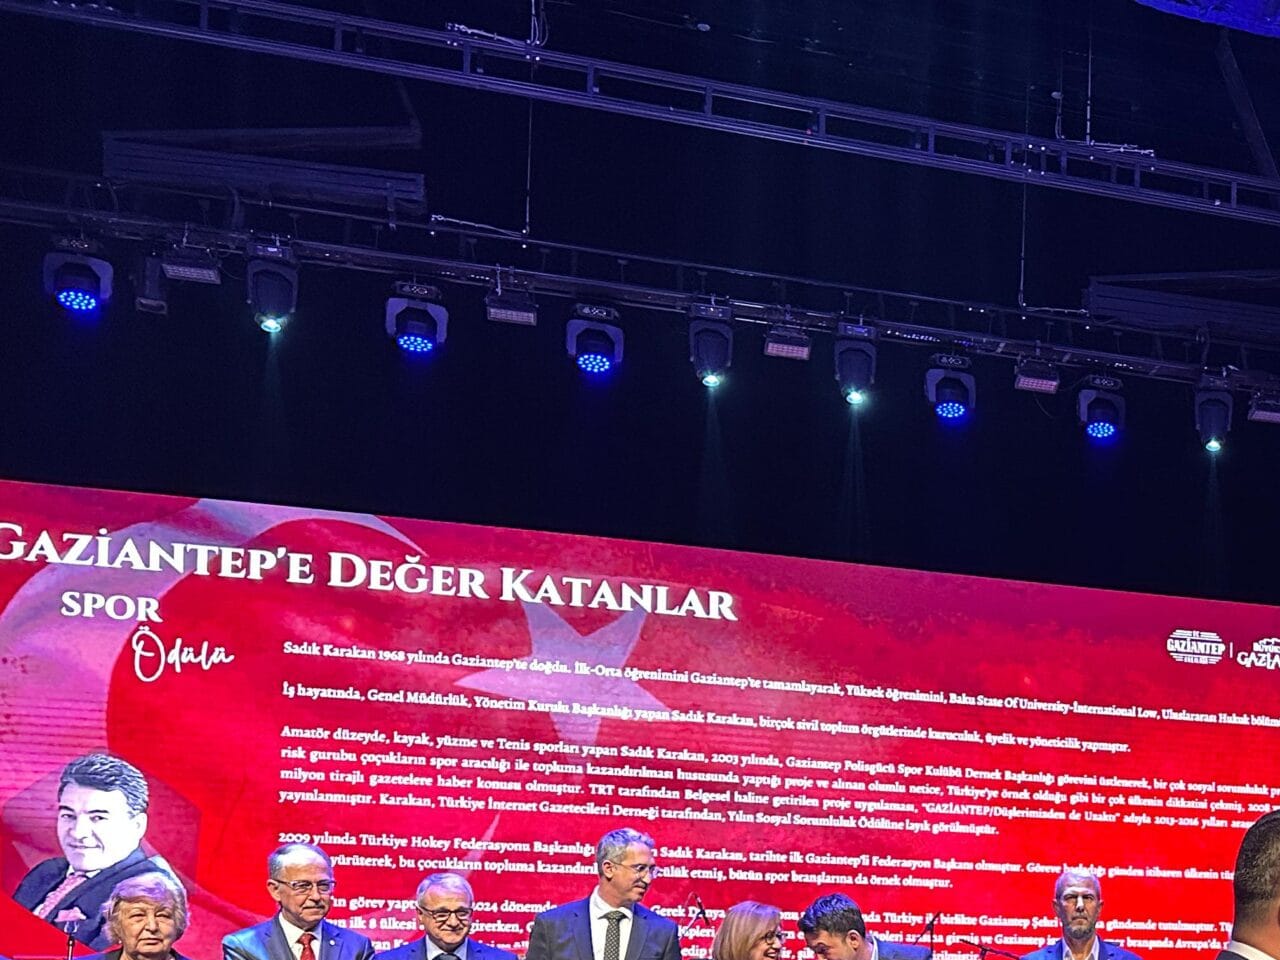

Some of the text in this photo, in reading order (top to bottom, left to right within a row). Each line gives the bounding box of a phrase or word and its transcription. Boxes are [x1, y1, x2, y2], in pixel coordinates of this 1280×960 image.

[0, 522, 738, 621] GAZİANTEP'E DEĞER KATANLAR
[61, 591, 163, 622] SPOR
[132, 626, 235, 682] Ödülü
[283, 641, 319, 656] Sadık
[323, 644, 375, 660] Karakan
[378, 650, 404, 662] 1968
[406, 650, 449, 665] yılında
[529, 658, 571, 676] doğdu.
[624, 667, 688, 683] öğrenimini
[763, 679, 844, 697] tamamlayarak,
[846, 684, 883, 698] Yüksek
[949, 693, 974, 705] Baku
[977, 695, 1002, 707] State
[1004, 697, 1018, 709] Of
[283, 681, 294, 698] İş
[297, 683, 364, 701] hayatında,
[367, 689, 403, 703] Genel
[406, 691, 471, 708] Müdürlük,
[474, 696, 525, 711] Yönetim
[528, 699, 569, 714] Kurulu
[572, 702, 632, 721] Başkanlığı
[634, 709, 669, 722] yapan
[672, 709, 704, 723] Sadık
[706, 712, 756, 728] Karakan,
[759, 715, 793, 731] birçok
[796, 718, 818, 731] sivil
[1017, 737, 1027, 746] ve
[281, 725, 329, 739] Amatör
[333, 727, 389, 745] düzeyde,
[393, 731, 433, 747] kayak,
[436, 735, 477, 749] yüzme
[481, 739, 494, 749] ve
[497, 738, 529, 751] Tenis
[533, 741, 578, 755] sporları
[581, 745, 617, 758] yapan
[620, 745, 653, 759] Sadık
[657, 748, 708, 763] Karakan,
[711, 753, 737, 765] 2003
[741, 753, 782, 768] yılında,
[786, 756, 840, 773] Gaziantep
[844, 760, 894, 776] Polisgücü
[897, 763, 921, 778] Spor
[965, 767, 1001, 780] Dernek
[1153, 778, 1166, 789] bir
[1169, 780, 1184, 792] çok
[281, 746, 305, 759] risk
[310, 749, 356, 763] gurubu
[430, 757, 457, 770] spor
[461, 757, 510, 773] aracılığı
[514, 758, 529, 771] ile
[532, 760, 582, 775] topluma
[676, 768, 738, 783] hususunda
[784, 776, 813, 790] proje
[816, 780, 828, 789] ve
[832, 778, 864, 791] alınan
[1091, 793, 1104, 804] bir
[1108, 794, 1124, 807] çok
[278, 789, 375, 806] yayınlanmıştır.
[379, 793, 434, 808] Karakan,
[437, 796, 485, 812] Türkiye
[488, 798, 536, 812] İnternet
[539, 801, 609, 815] Gazetecileri
[612, 804, 658, 820] Derneği
[661, 807, 725, 823] tarafından,
[727, 810, 753, 823] Yılın
[756, 812, 790, 827] Sosyal
[280, 767, 324, 783] milyon
[329, 770, 364, 785] tirajlı
[369, 773, 432, 787] gazetelere
[437, 774, 472, 788] haber
[477, 776, 521, 791] konusu
[525, 779, 584, 796] olmuştur.
[589, 783, 614, 796] TRT
[618, 785, 679, 799] tarafından
[684, 788, 729, 804] Belgesel
[734, 790, 768, 804] haline
[772, 794, 818, 808] getirilen
[822, 797, 850, 811] proje
[279, 832, 312, 845] 2009
[312, 831, 356, 847] yılında
[359, 833, 407, 849] Türkiye
[411, 835, 450, 852] Hokey
[453, 837, 529, 854] Federasyonu
[660, 846, 692, 859] Sadık
[696, 848, 746, 862] Karakan,
[749, 850, 786, 863] tarihte
[789, 851, 802, 863] ilk
[872, 855, 930, 870] Federasyon
[331, 854, 395, 869] yürüterek,
[399, 855, 415, 868] bu
[417, 857, 481, 873] çocukların
[484, 859, 534, 874] topluma
[729, 867, 761, 881] bütün
[764, 872, 788, 884] spor
[855, 873, 867, 885] da
[870, 874, 900, 886] örnek
[349, 896, 383, 911] görev
[349, 916, 365, 929] ilk
[380, 917, 416, 930] ülkesi
